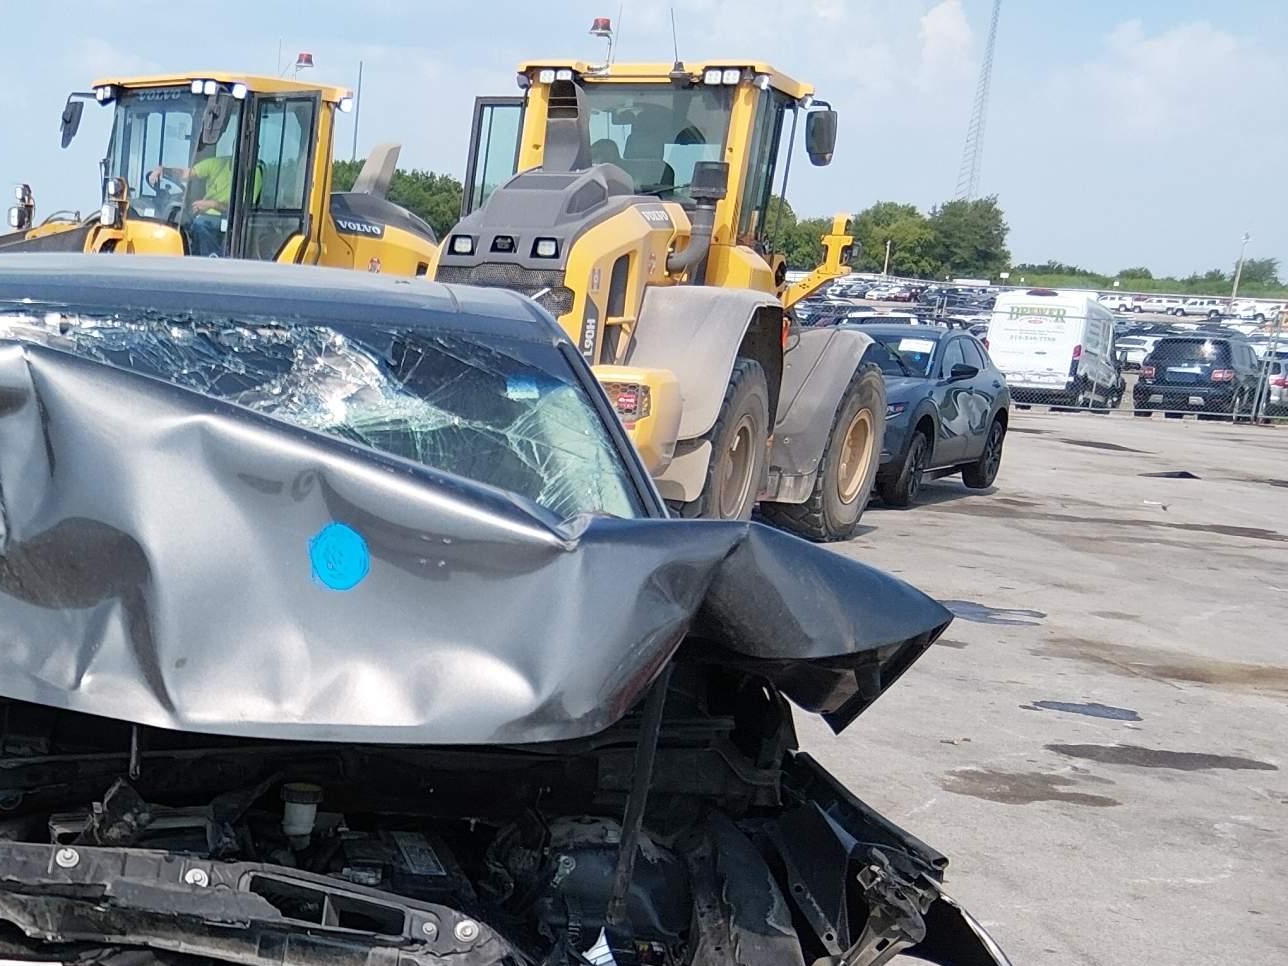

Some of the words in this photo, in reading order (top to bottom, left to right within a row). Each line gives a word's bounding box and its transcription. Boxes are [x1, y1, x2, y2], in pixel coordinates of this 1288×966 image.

[137, 88, 181, 101] VOLVO
[336, 219, 382, 235] VOLVO
[583, 318, 596, 357] L90H
